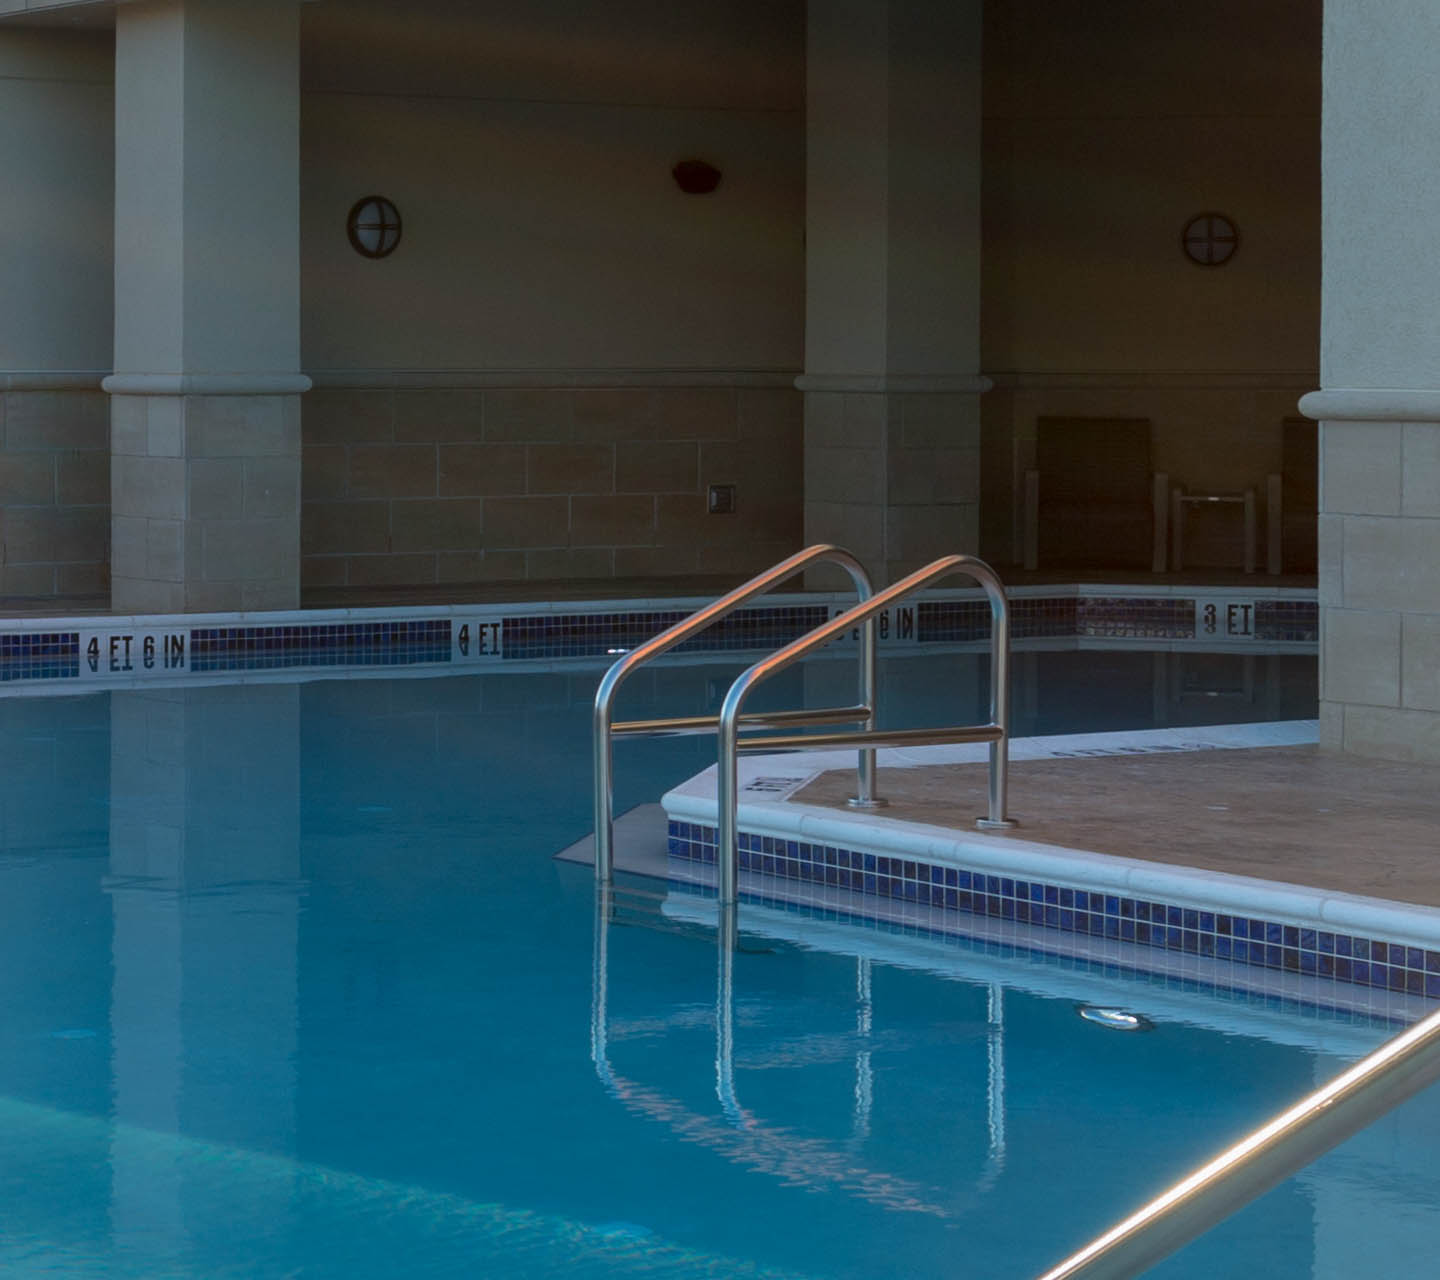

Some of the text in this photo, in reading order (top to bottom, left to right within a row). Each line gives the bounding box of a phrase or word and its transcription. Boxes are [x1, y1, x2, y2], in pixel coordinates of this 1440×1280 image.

[87, 634, 184, 656] 4 FT 6 IN
